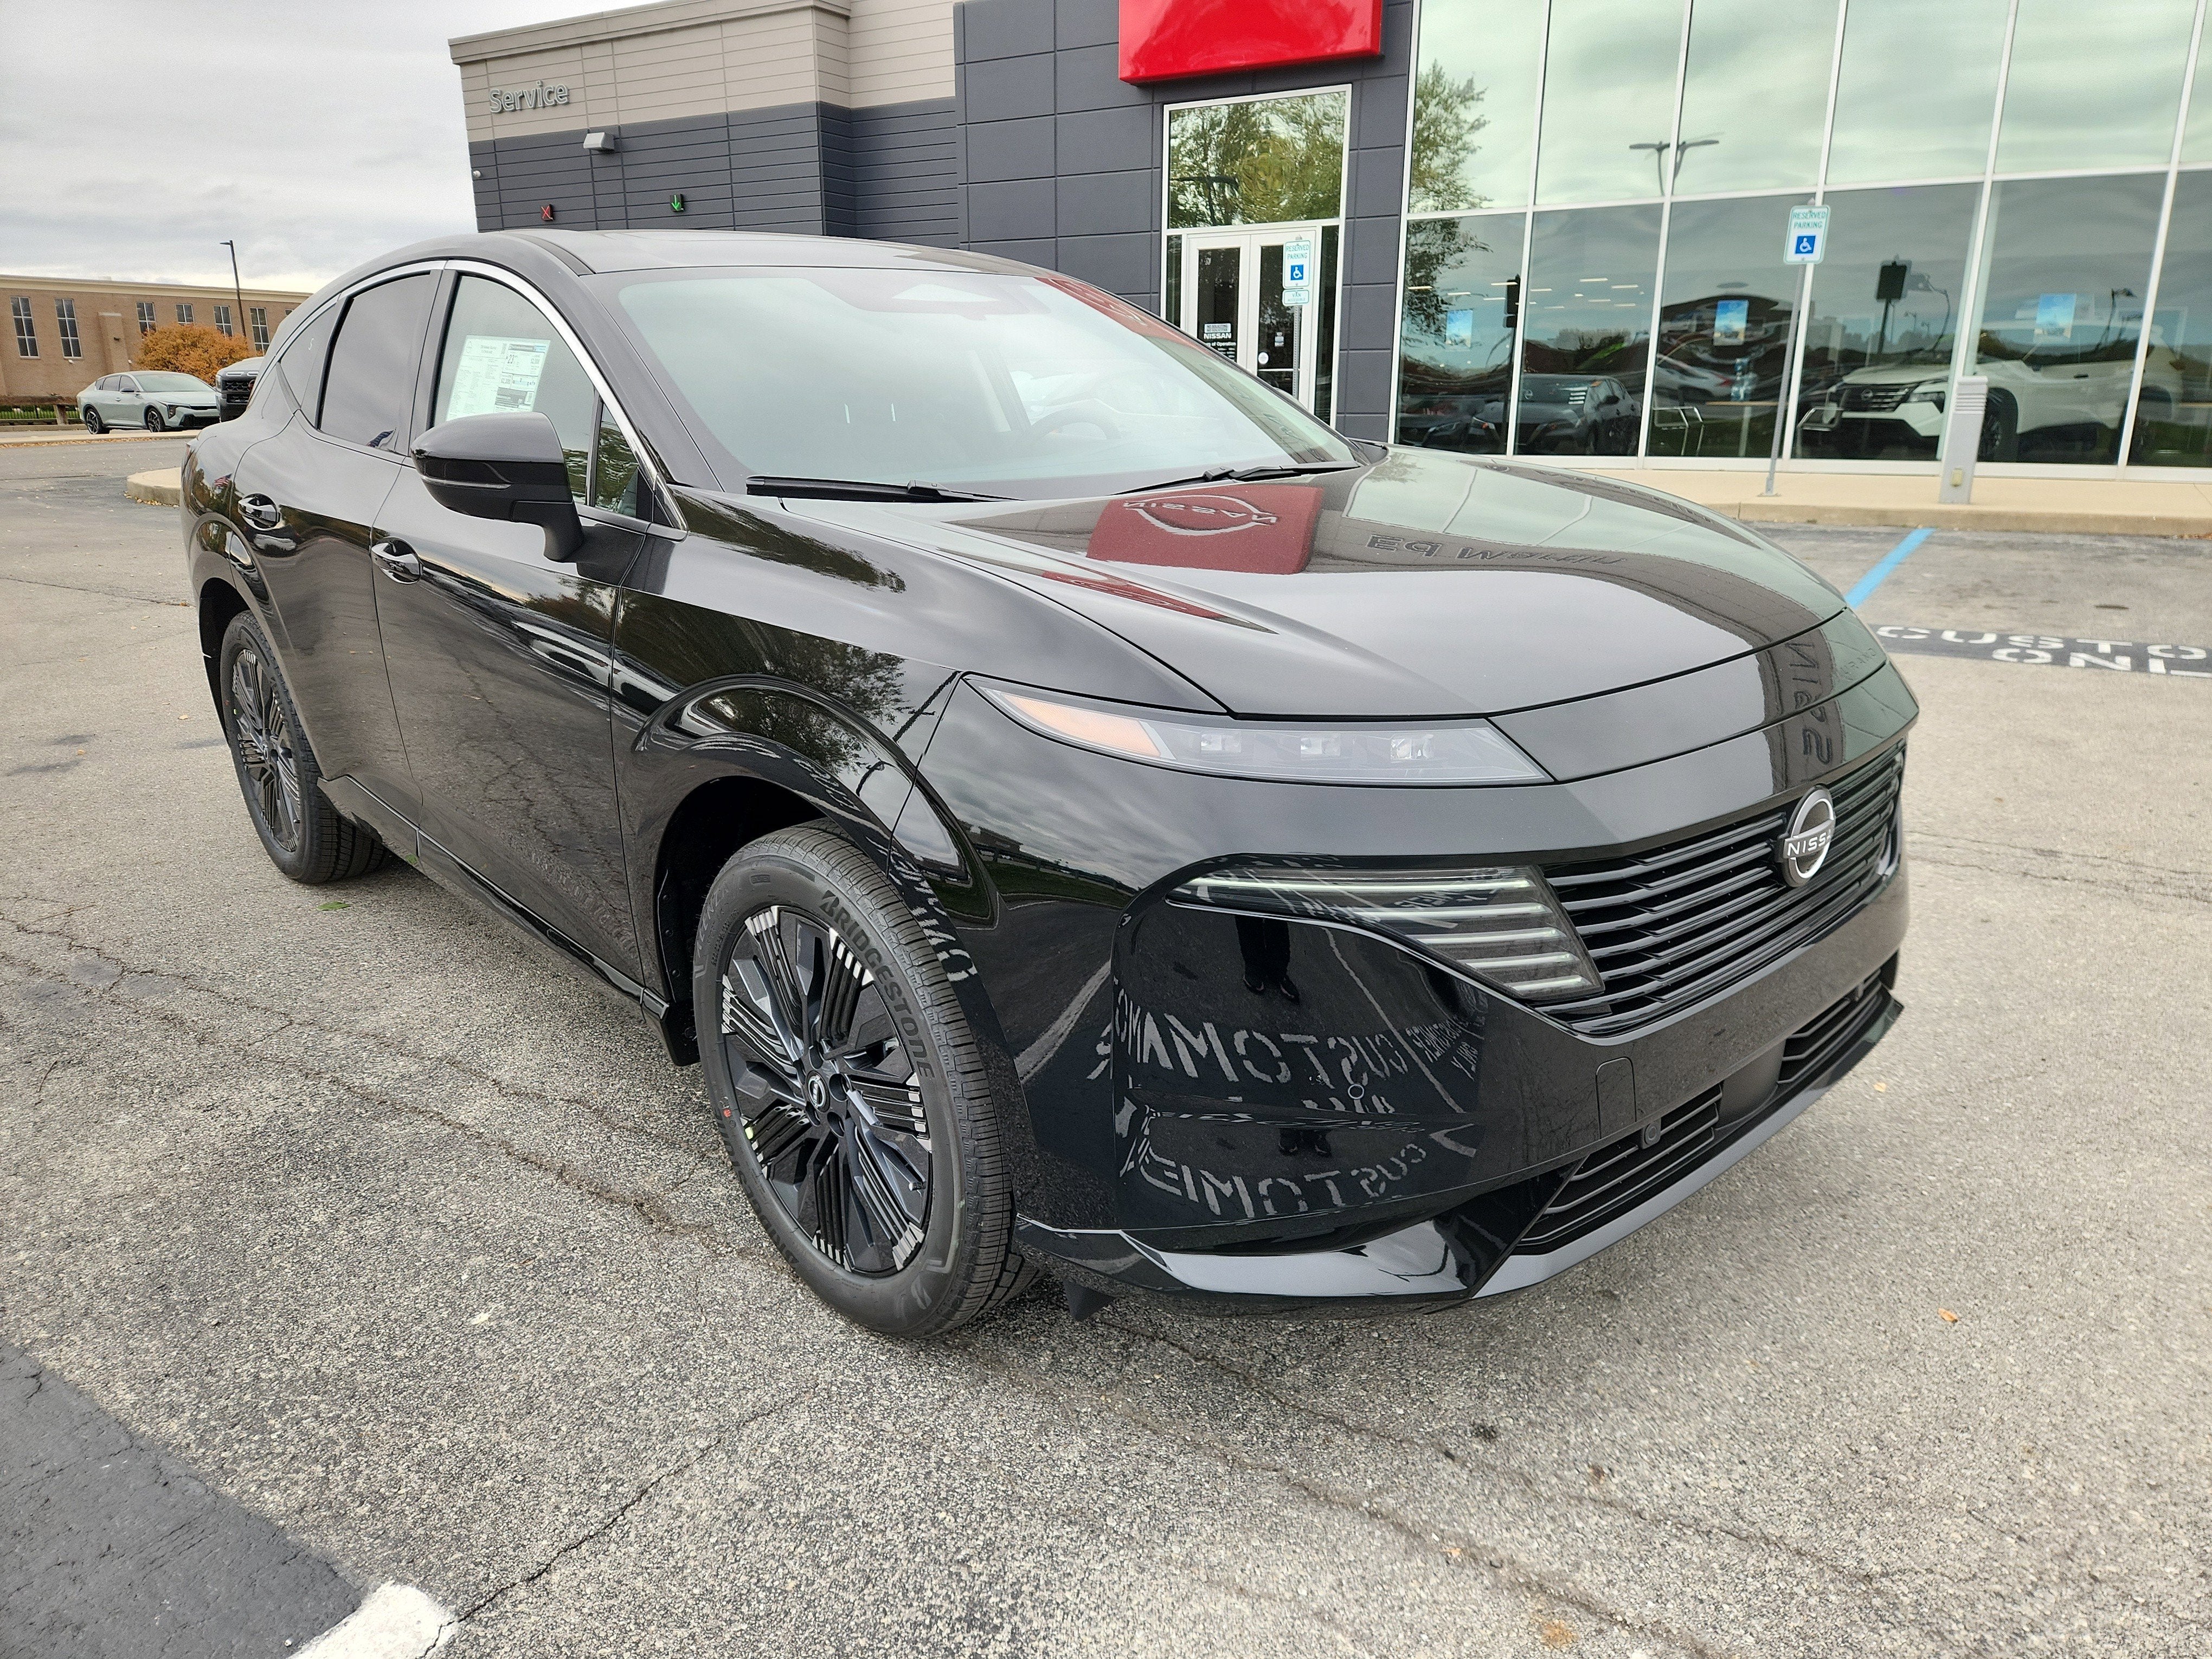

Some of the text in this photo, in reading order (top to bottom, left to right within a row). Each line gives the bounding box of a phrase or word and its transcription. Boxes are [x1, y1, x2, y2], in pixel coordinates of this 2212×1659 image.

[489, 80, 568, 113] Service
[1792, 211, 1825, 219] RESERVED
[819, 889, 935, 1079] BRIDGESTONE
